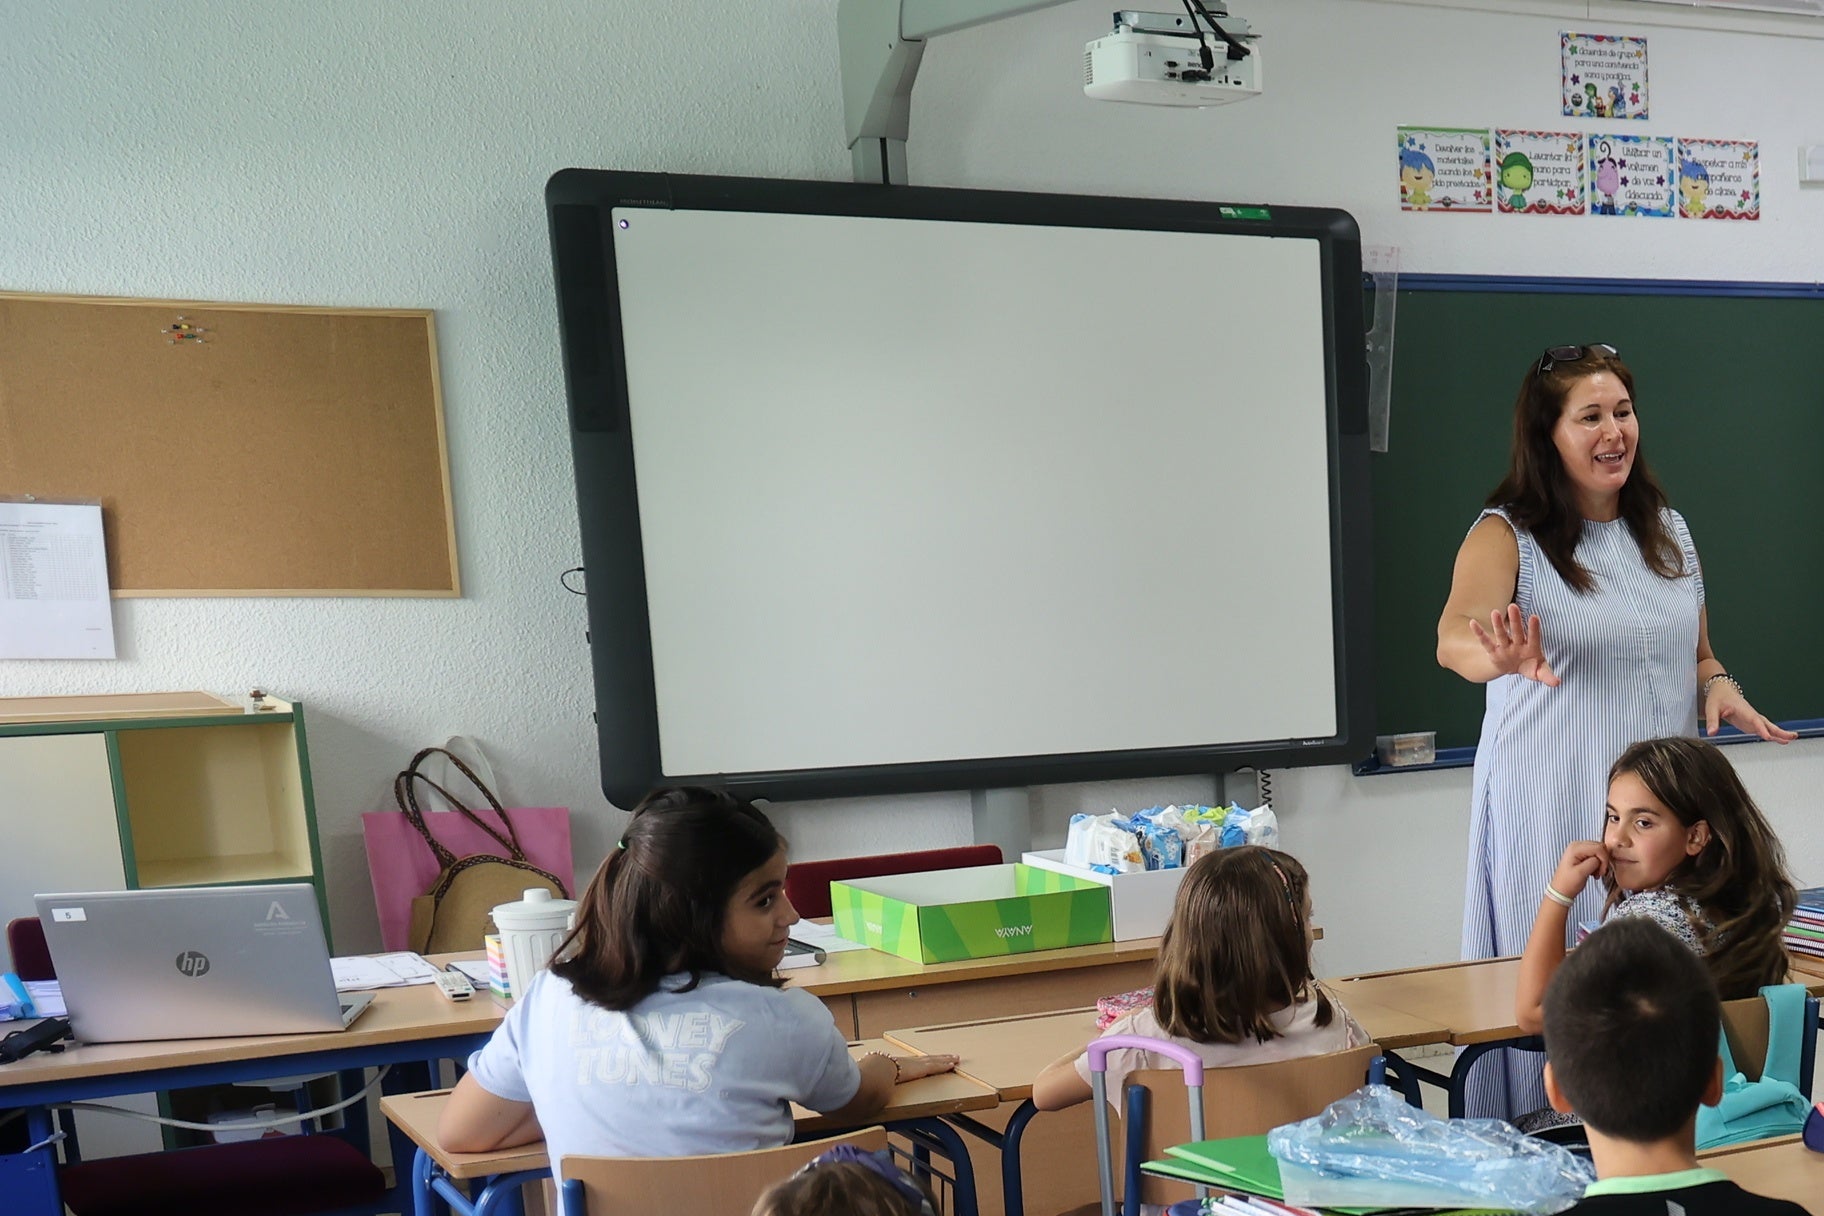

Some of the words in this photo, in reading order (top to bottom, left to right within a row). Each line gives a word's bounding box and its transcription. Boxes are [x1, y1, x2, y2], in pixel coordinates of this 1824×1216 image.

[995, 924, 1033, 939] ANAYA
[181, 950, 206, 978] hp
[567, 1010, 747, 1054] LOONEY
[575, 1047, 717, 1093] TUNES
